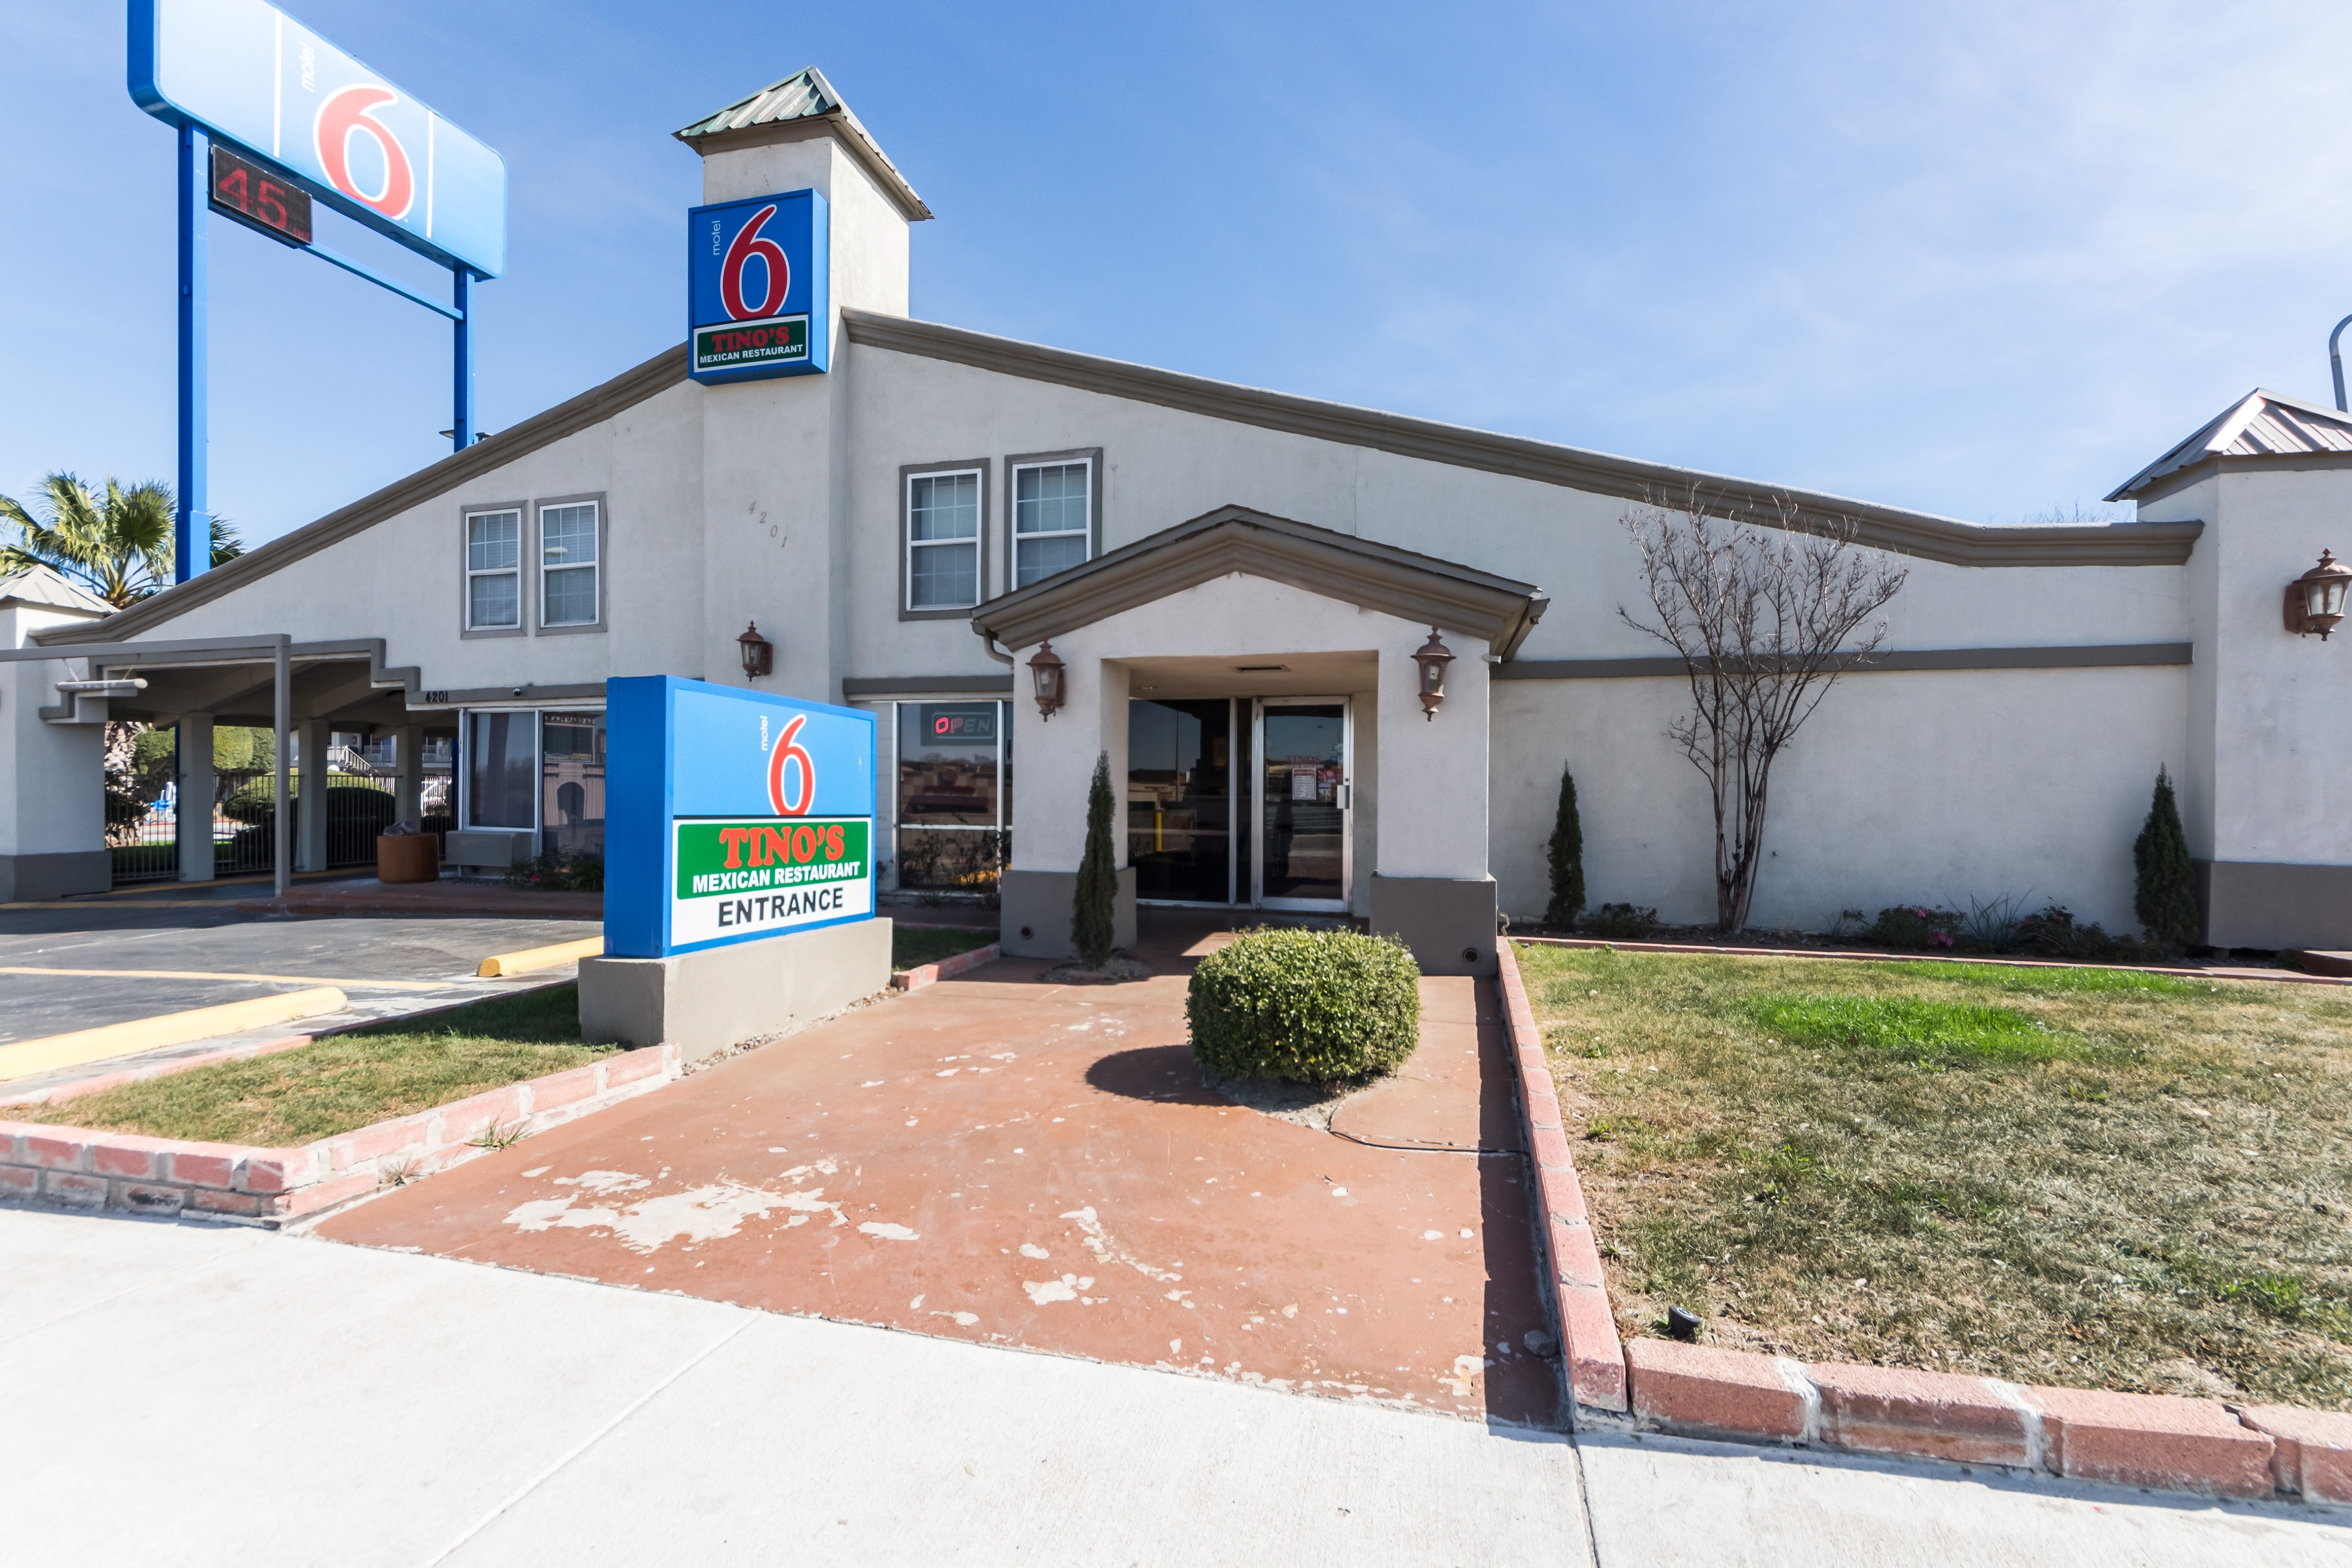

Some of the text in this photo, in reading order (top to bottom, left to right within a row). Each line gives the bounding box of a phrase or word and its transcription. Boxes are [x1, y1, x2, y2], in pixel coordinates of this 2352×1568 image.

[298, 40, 315, 92] motel
[313, 83, 414, 221] 6
[218, 168, 287, 228] 45
[712, 220, 721, 255] motel
[720, 204, 790, 320] 6
[700, 344, 803, 364] MEXICAN RESTAURANT
[712, 326, 790, 352] TINO'S
[748, 501, 787, 548] 4201
[425, 691, 448, 703] 4201
[760, 716, 768, 751] motel
[936, 717, 991, 733] OPEN
[767, 713, 816, 815] 6
[719, 825, 844, 869] TINO'S
[692, 861, 860, 893] MEXICAN RESTAURANT
[718, 887, 843, 928] ENTRANCE
